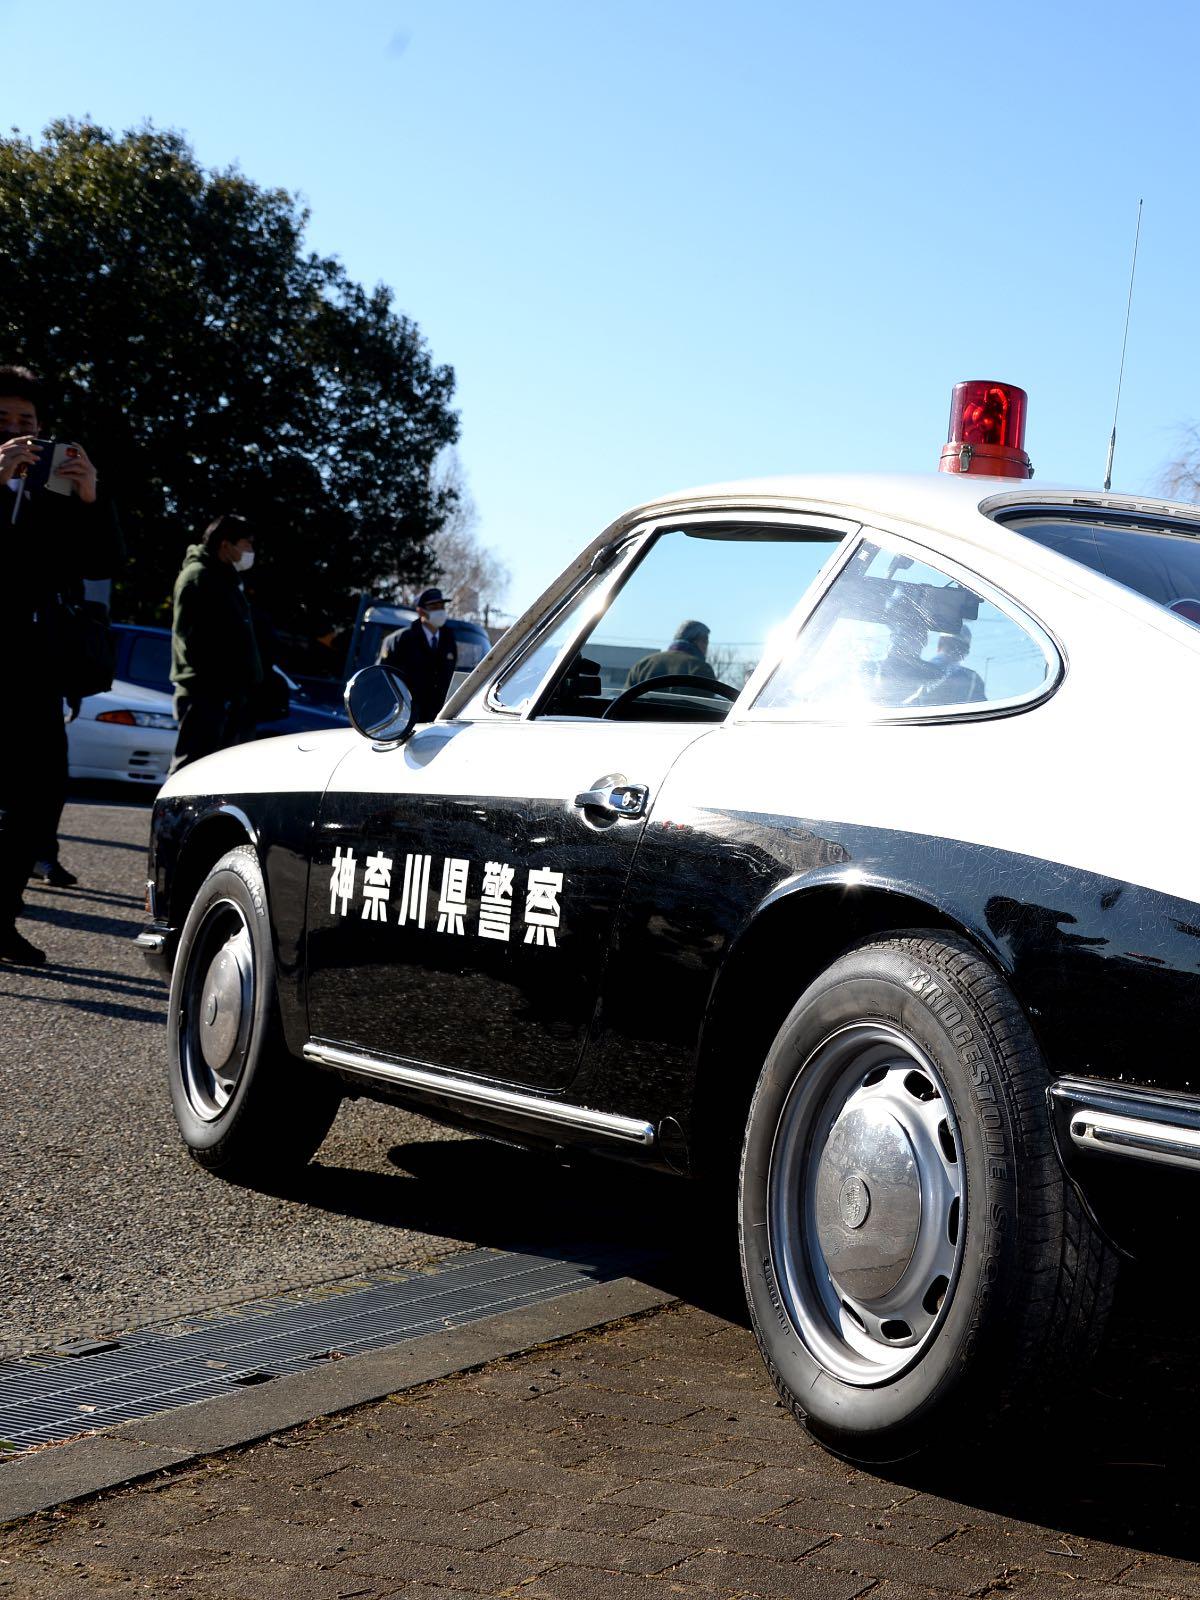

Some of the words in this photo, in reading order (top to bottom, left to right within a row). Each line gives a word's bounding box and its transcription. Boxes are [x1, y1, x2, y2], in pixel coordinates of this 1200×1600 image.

[330, 846, 564, 948] 神奈川県警察
[905, 967, 1008, 1180] BRIDGESTONE
